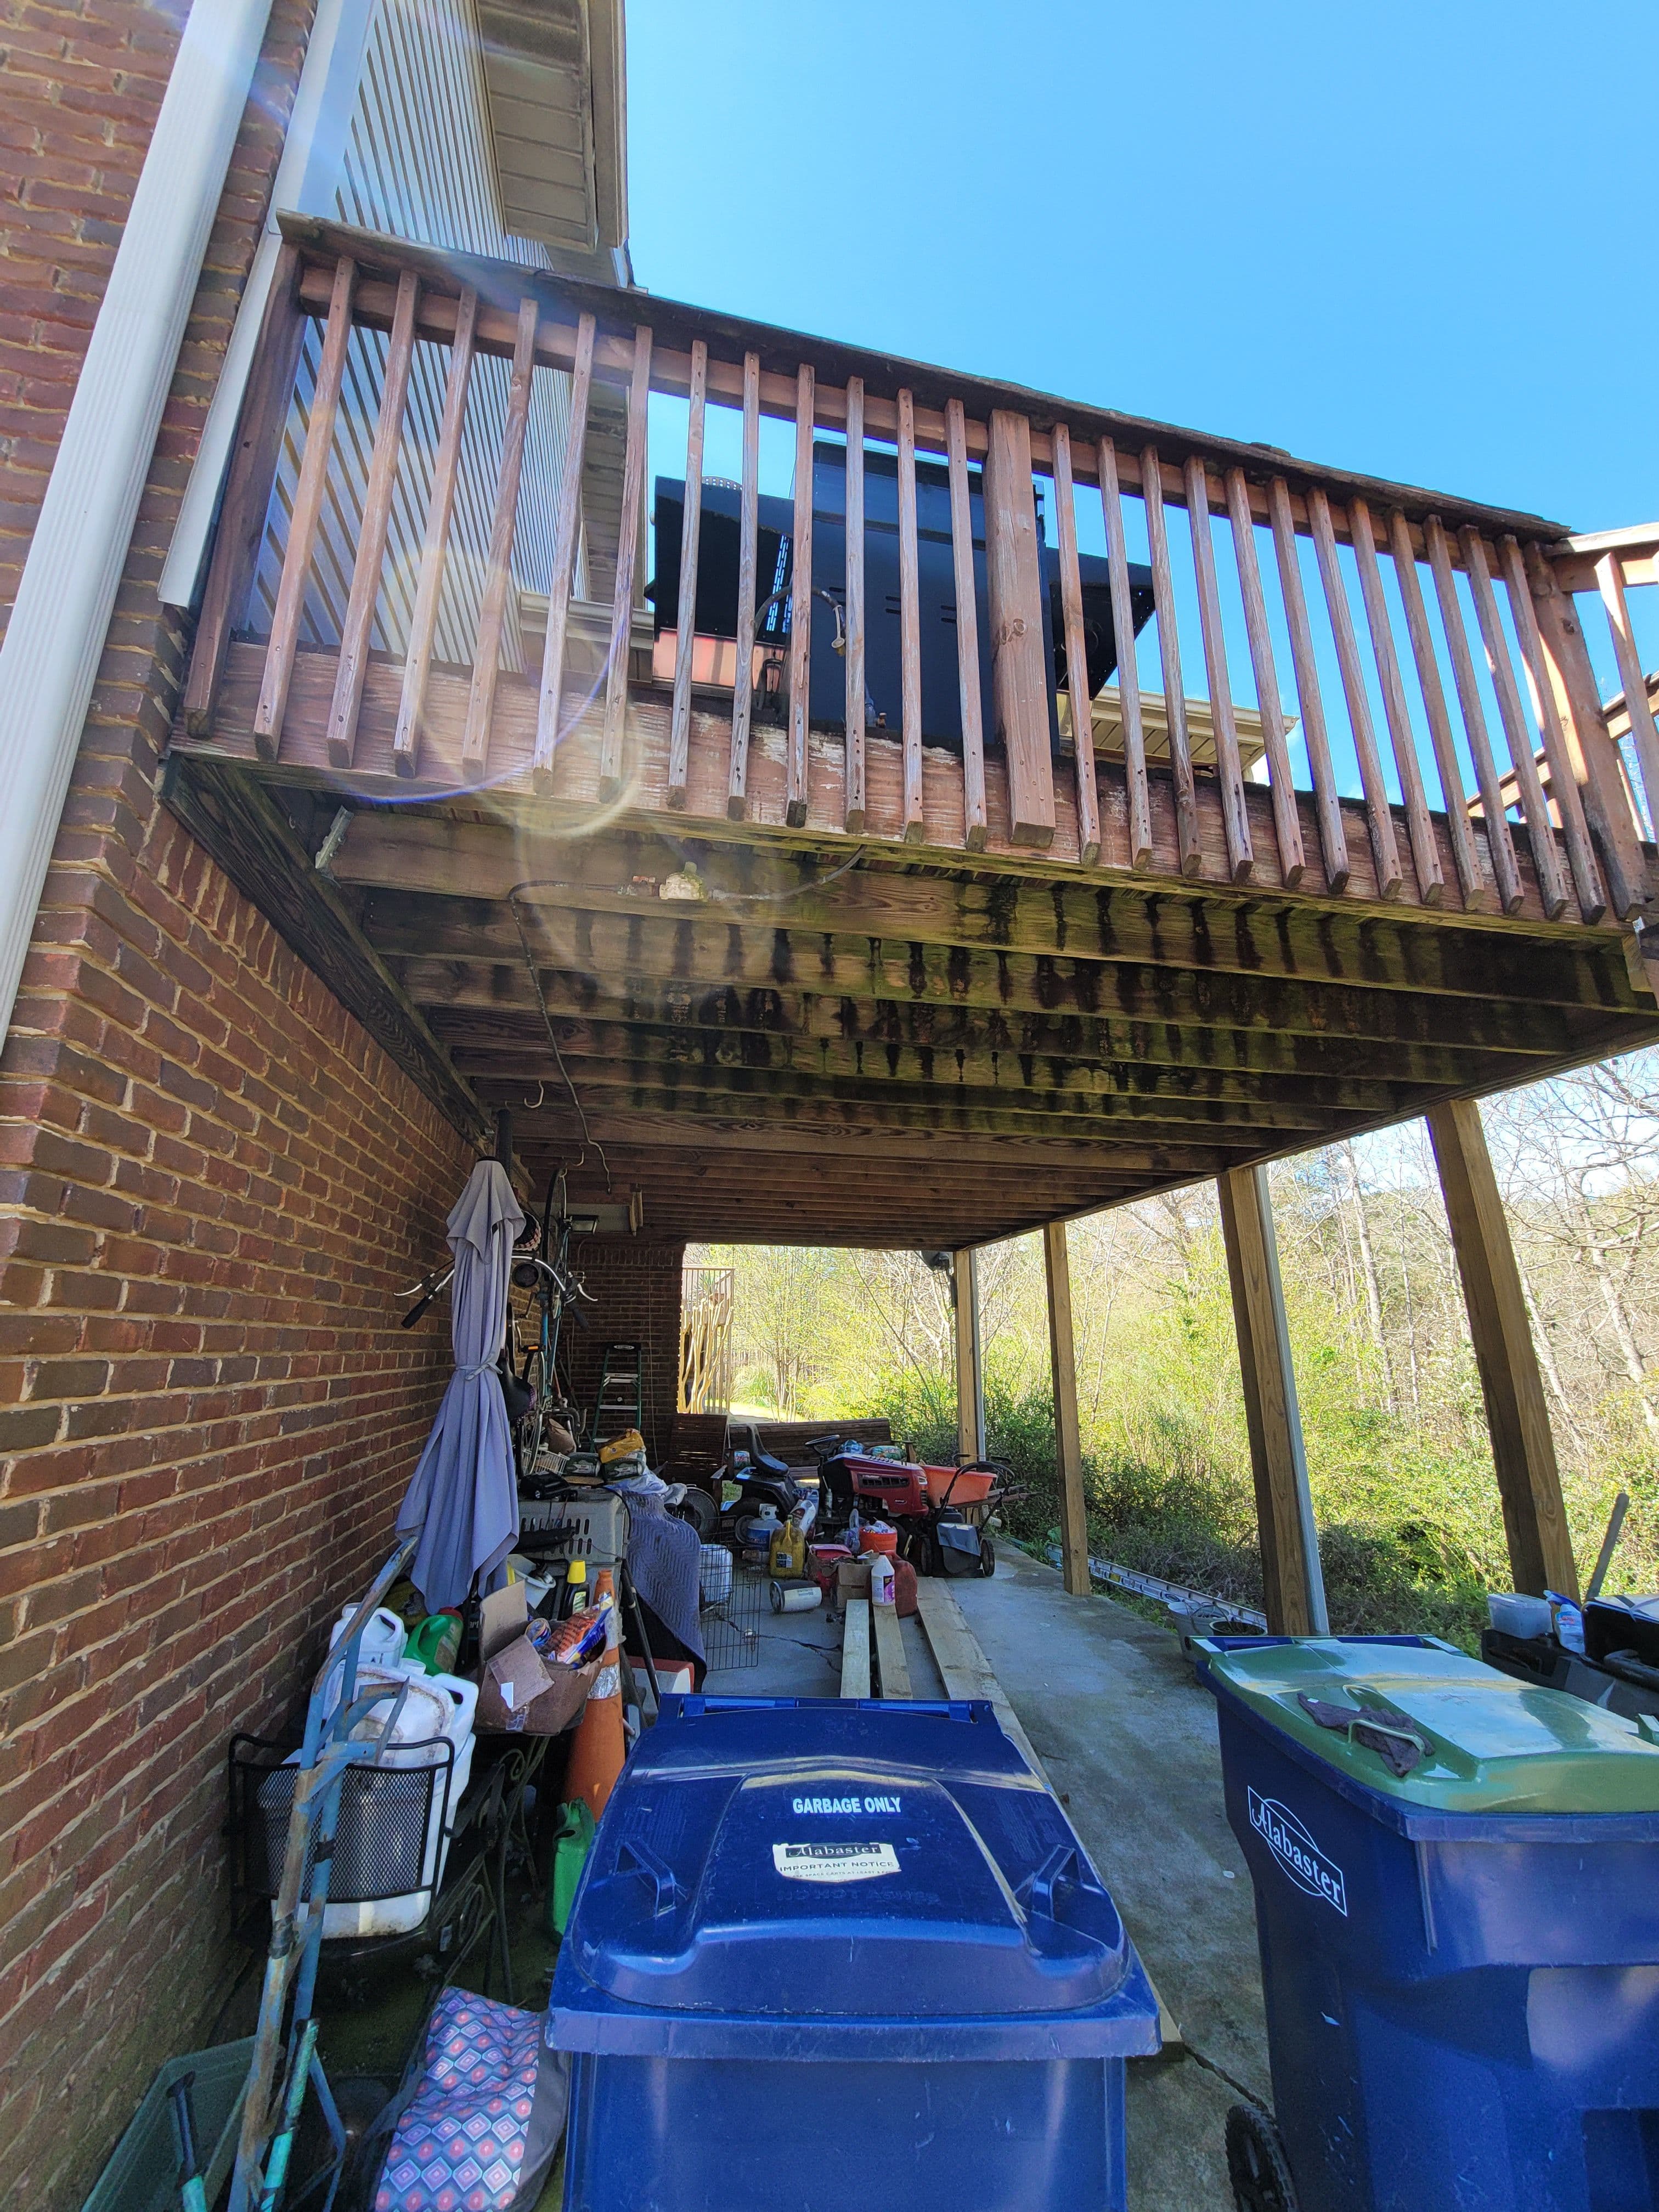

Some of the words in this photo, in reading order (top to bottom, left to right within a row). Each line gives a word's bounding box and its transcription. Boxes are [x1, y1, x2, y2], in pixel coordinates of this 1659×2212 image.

[793, 1798, 862, 1814] GARBAGE
[864, 1797, 902, 1813] ONLY
[788, 1845, 879, 1857] Alabaster
[1251, 1803, 1341, 1904] Alabaster
[780, 1863, 848, 1872] IMPORTANT
